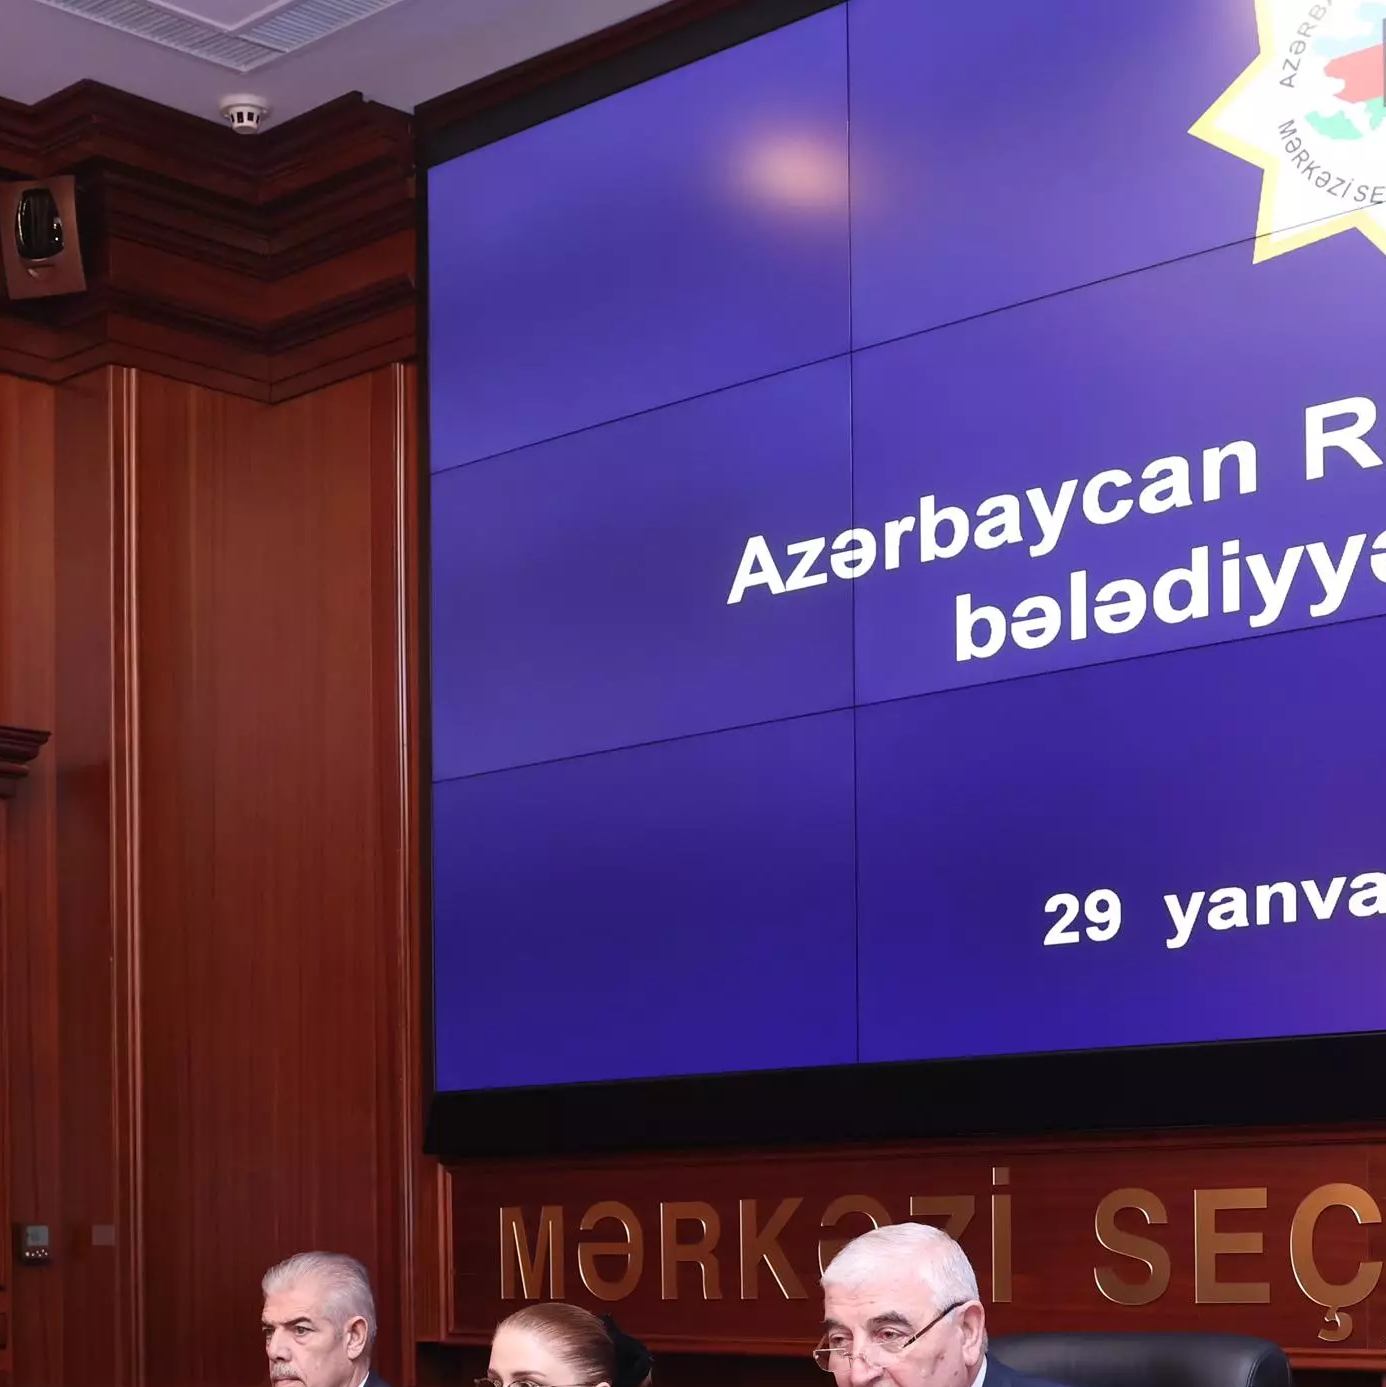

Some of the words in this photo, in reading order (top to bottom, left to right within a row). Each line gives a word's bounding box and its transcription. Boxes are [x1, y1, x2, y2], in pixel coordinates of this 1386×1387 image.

[1279, 0, 1332, 88] AZƏRB
[1278, 119, 1354, 199] MƏRKƏZİ
[727, 440, 1257, 604] Azərbaycan
[1042, 889, 1121, 945] 29
